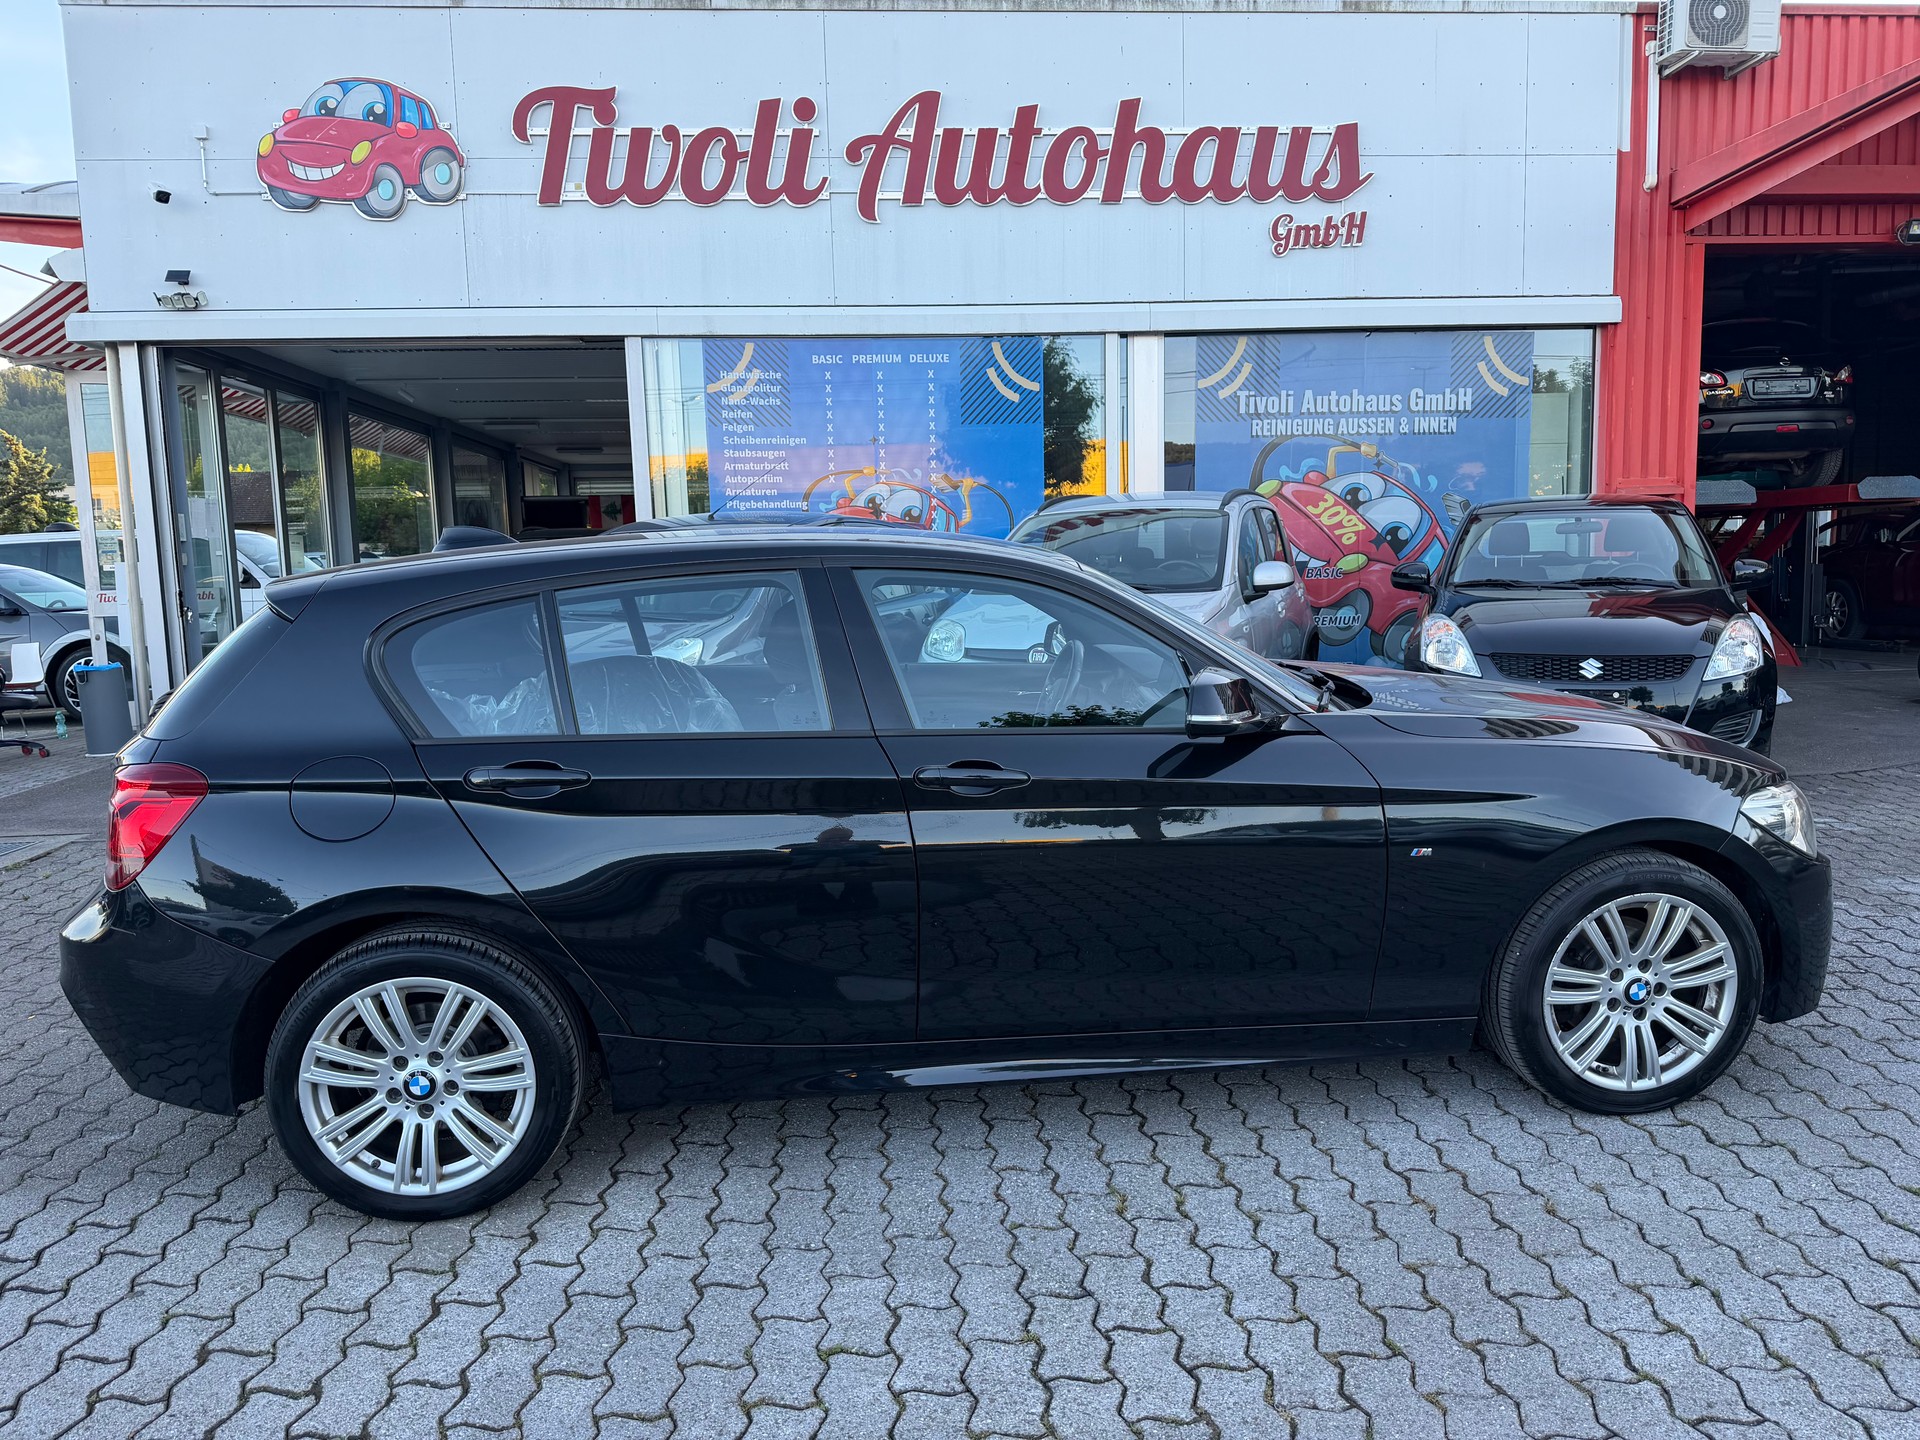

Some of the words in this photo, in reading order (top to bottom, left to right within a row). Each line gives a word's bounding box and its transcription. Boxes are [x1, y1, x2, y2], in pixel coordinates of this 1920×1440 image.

[511, 85, 831, 208] Tivoli
[844, 88, 1376, 224] Autohaus
[1269, 209, 1368, 258] GmbH
[812, 355, 843, 364] BASIC
[852, 354, 902, 364] PREMIUM
[909, 353, 950, 363] DELUXE
[719, 370, 782, 380] Handwäsche
[720, 384, 782, 395] Glanzpolitur
[721, 397, 781, 406] Nano-Wachs
[1237, 389, 1294, 413] Tivoli
[1301, 388, 1402, 412] Autohaus
[1409, 387, 1472, 411] GmbH
[722, 410, 753, 419] Reifen
[722, 423, 755, 434] Felgen
[1251, 419, 1333, 435] REINIGUNG
[1338, 418, 1394, 434] AUSSEN
[1400, 417, 1408, 433] &
[1414, 417, 1456, 432] INNEN
[723, 436, 807, 447] Scheibenreinigen
[724, 449, 786, 460] Staubsaugen
[724, 462, 789, 471] Armaturbrett
[725, 475, 783, 485] Autoparfüm
[726, 488, 778, 497] Armaturen
[1306, 493, 1366, 545] 30%
[1305, 567, 1343, 579] BASIC
[1314, 614, 1361, 627] REMIUM
